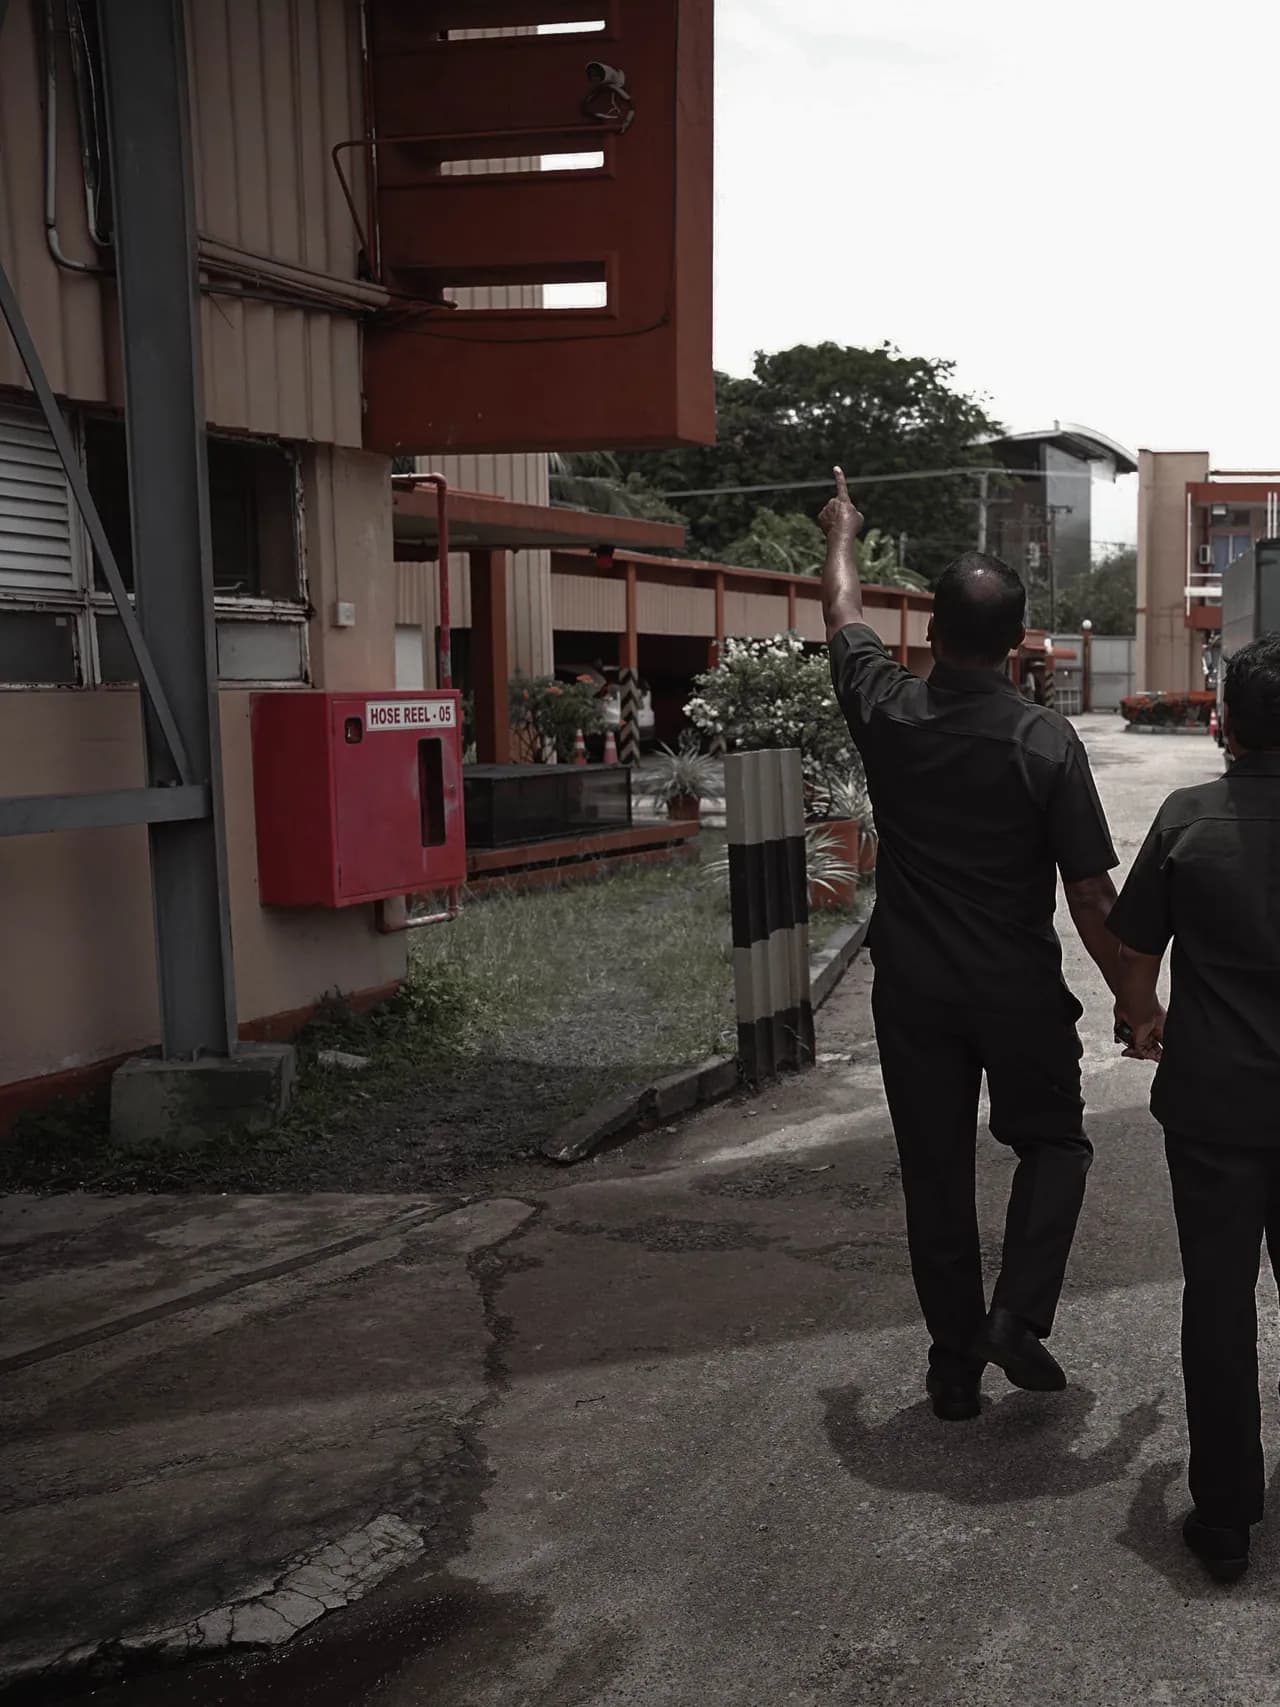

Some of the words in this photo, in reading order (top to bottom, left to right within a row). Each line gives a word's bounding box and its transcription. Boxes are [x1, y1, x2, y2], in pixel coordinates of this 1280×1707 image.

[371, 708, 400, 724] HOSE
[404, 706, 431, 723] REEL
[439, 705, 451, 722] 05
